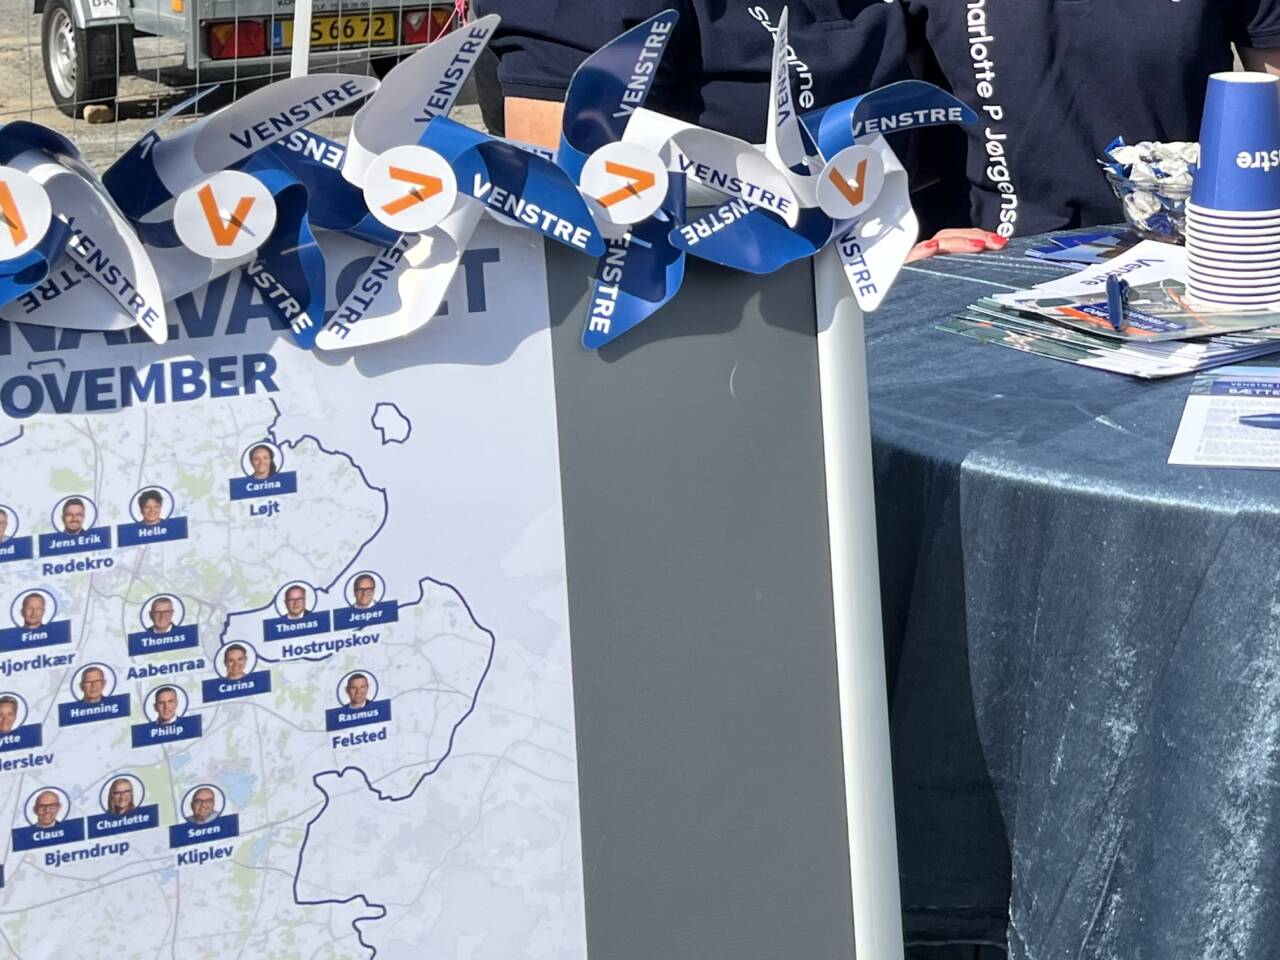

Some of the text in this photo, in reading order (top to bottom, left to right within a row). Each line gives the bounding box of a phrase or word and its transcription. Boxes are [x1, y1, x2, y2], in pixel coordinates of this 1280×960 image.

[747, 5, 815, 109] Suanne
[414, 26, 490, 124] VENSTRE
[613, 18, 674, 119] VENSTRE
[229, 79, 363, 150] VENSTRE
[850, 106, 963, 137] VENSTRE
[982, 104, 1003, 121] P
[677, 153, 793, 216] VENSTRE
[983, 126, 1017, 240] Jørgense
[473, 173, 593, 250] VENSTRE
[680, 196, 758, 247] NSTRE
[839, 231, 878, 298] NSTRE
[1080, 258, 1165, 287] Venre
[588, 231, 631, 335] ENSTRE
[247, 258, 314, 336] NSTRE
[0, 351, 280, 419] OVEMBER
[246, 480, 281, 492] Carina
[250, 500, 281, 517] Løjt
[138, 526, 168, 538] Helle
[49, 535, 101, 550] Jens Erik
[42, 556, 115, 576] Rødekro
[348, 609, 383, 622] Jesper
[22, 631, 48, 642] Finn
[276, 620, 319, 633] Thomas
[141, 633, 186, 647] Thomas
[282, 632, 380, 658] Hostrupskov
[127, 658, 206, 680] Aabenraa
[219, 680, 255, 693] Carina
[70, 703, 119, 718] Henning
[338, 709, 379, 723] Rasmus
[151, 725, 183, 738] Philip
[332, 726, 387, 749] Felsted
[0, 753, 54, 771] erslev
[96, 813, 150, 830] Charlotte
[32, 829, 65, 841] Claus
[188, 826, 221, 838] Søren
[45, 840, 130, 867] Bjerndrup
[177, 846, 234, 866] Kliplev
